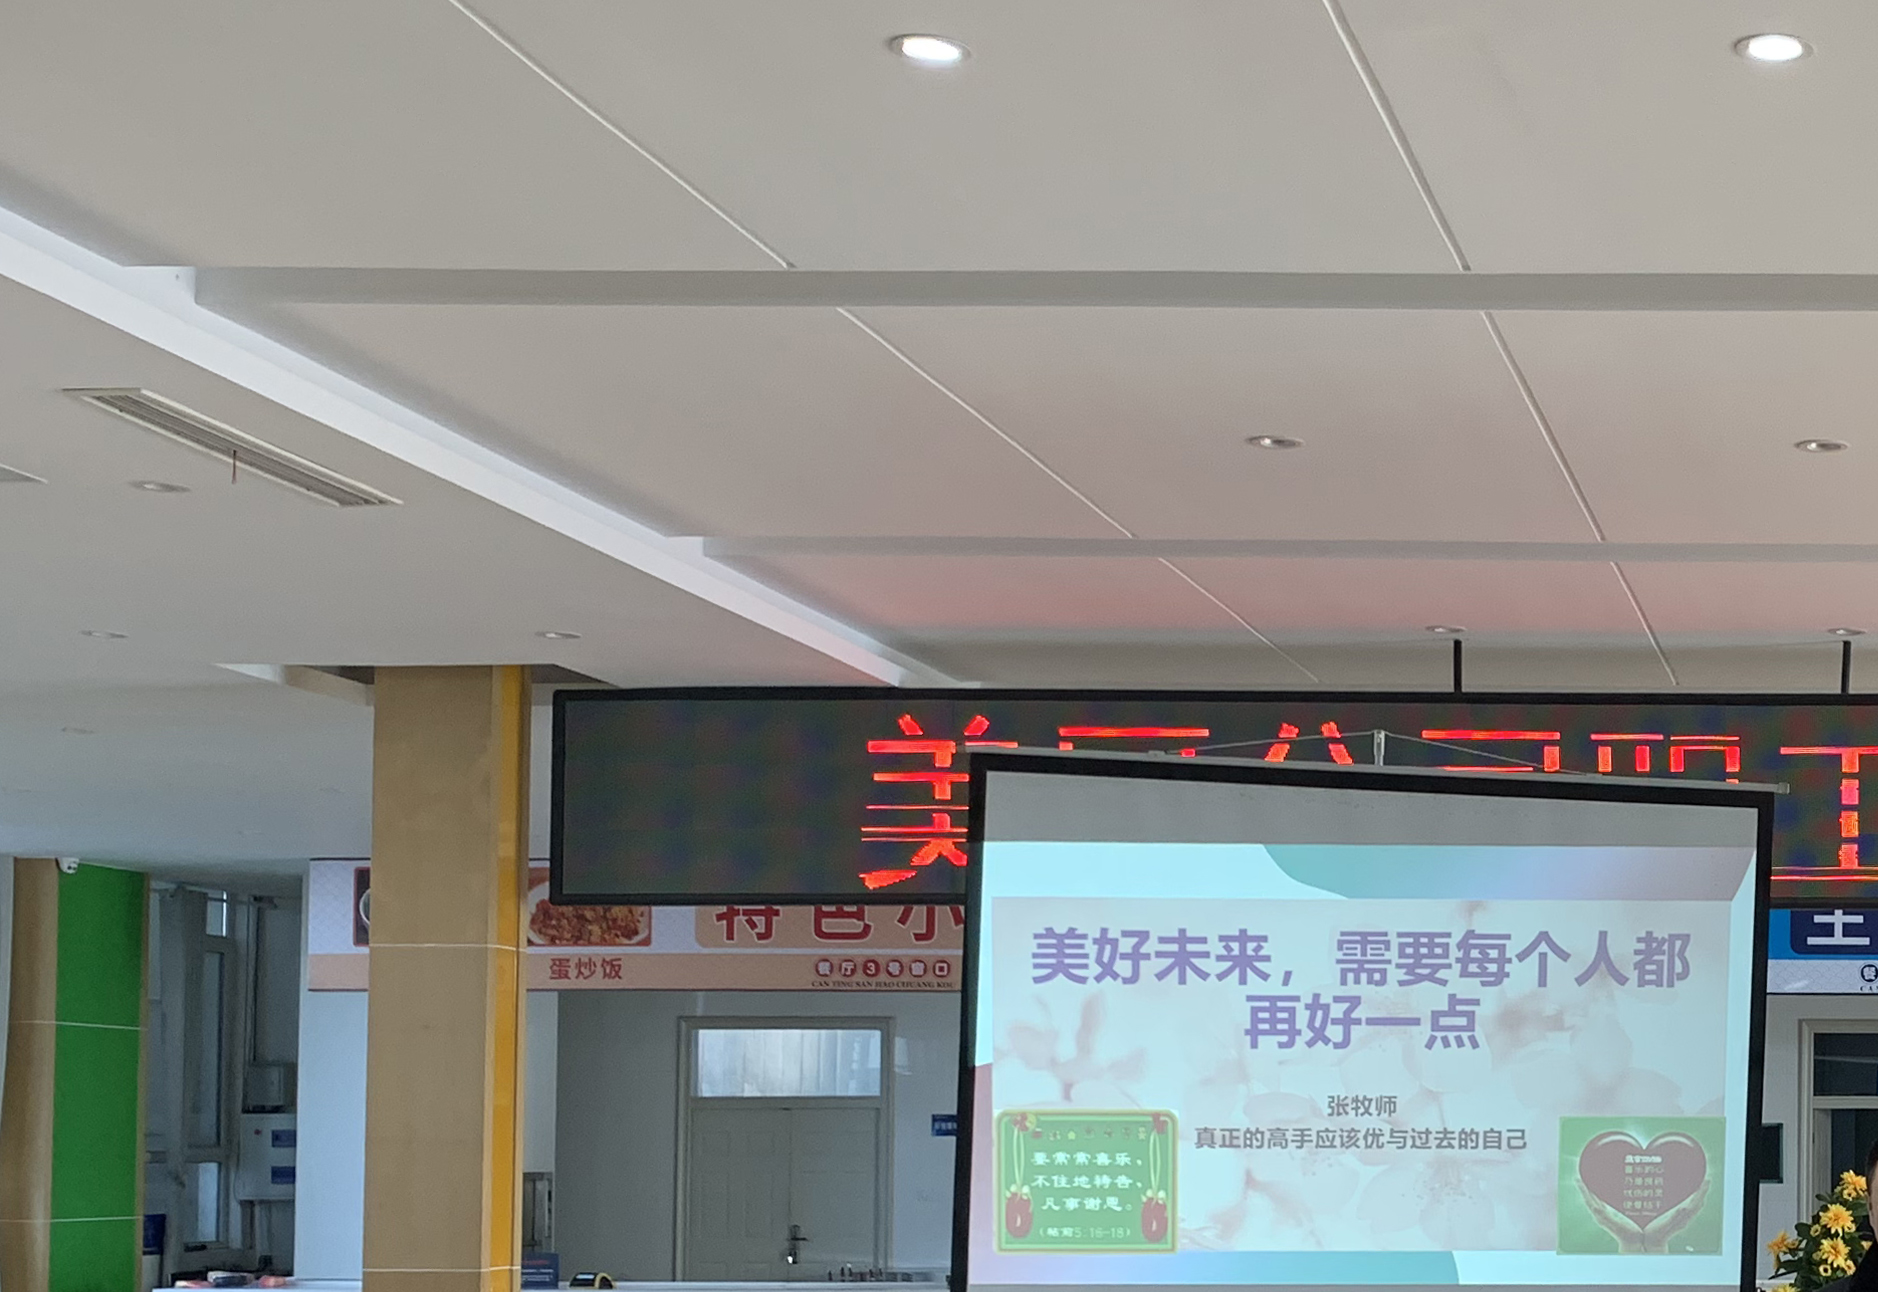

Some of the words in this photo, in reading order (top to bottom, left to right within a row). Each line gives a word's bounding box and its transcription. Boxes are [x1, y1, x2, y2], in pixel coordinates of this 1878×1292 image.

[548, 957, 623, 981] 蛋炒饭
[1031, 926, 1691, 988] 美好未来，需要每个人都
[1244, 993, 1482, 1051] 再好一点
[1326, 1095, 1398, 1118] 张牧师
[1194, 1128, 1528, 1151] 真正的高手应该优与过去的自己
